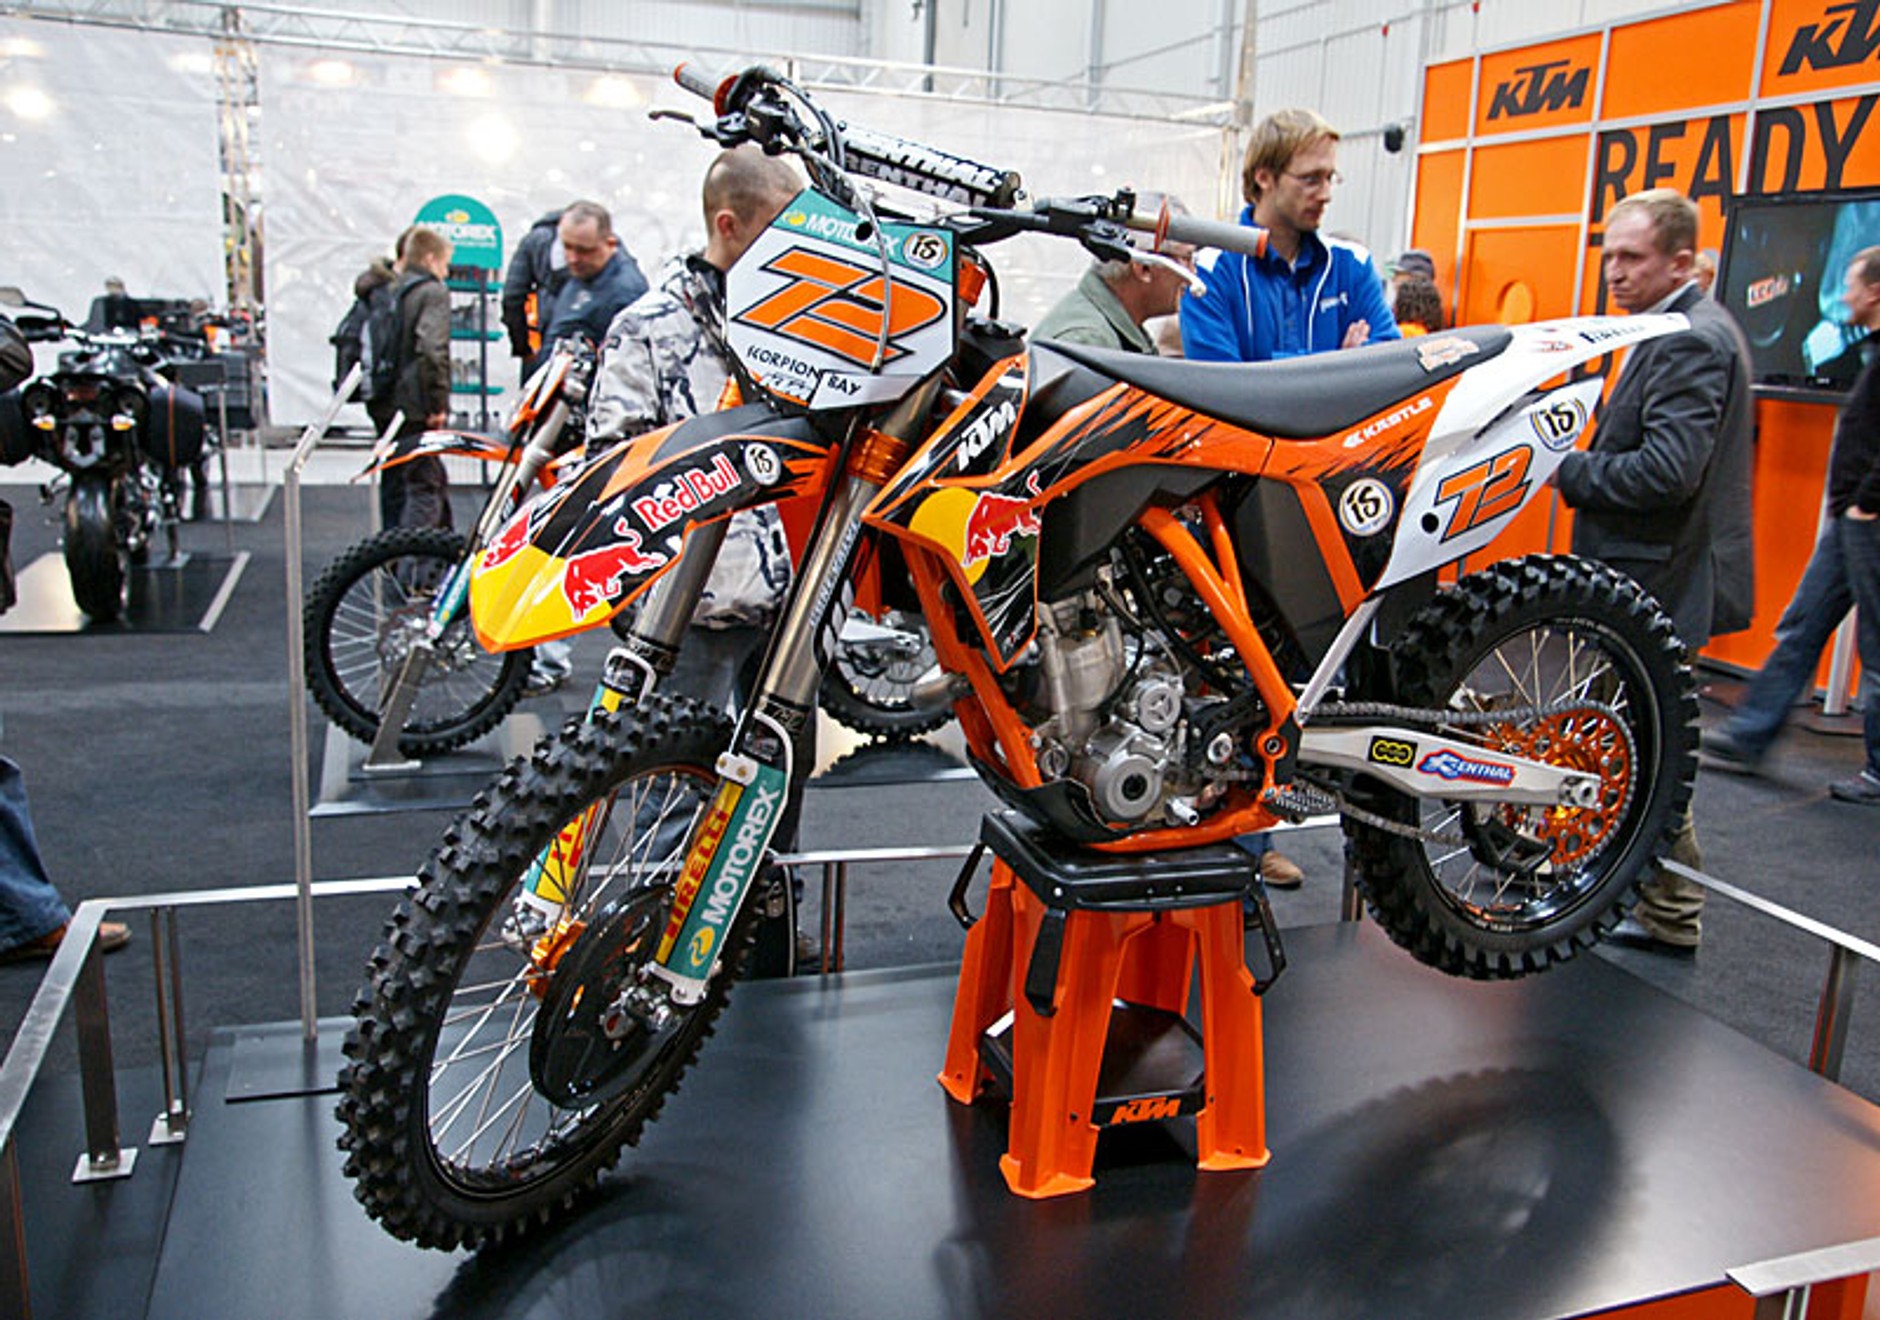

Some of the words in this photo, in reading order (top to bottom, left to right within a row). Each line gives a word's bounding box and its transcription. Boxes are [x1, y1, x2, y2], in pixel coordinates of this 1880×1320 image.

[1778, 0, 1880, 76] KT
[1486, 59, 1591, 121] KTM
[1590, 94, 1880, 223] READY
[730, 244, 948, 374] 72
[827, 374, 862, 396] BAY
[956, 401, 1017, 471] KTM
[631, 474, 696, 532] Red
[685, 451, 742, 503] Bull
[1434, 444, 1534, 544] 72
[701, 786, 782, 925] MOTOREX
[1110, 1096, 1181, 1125] KTM
